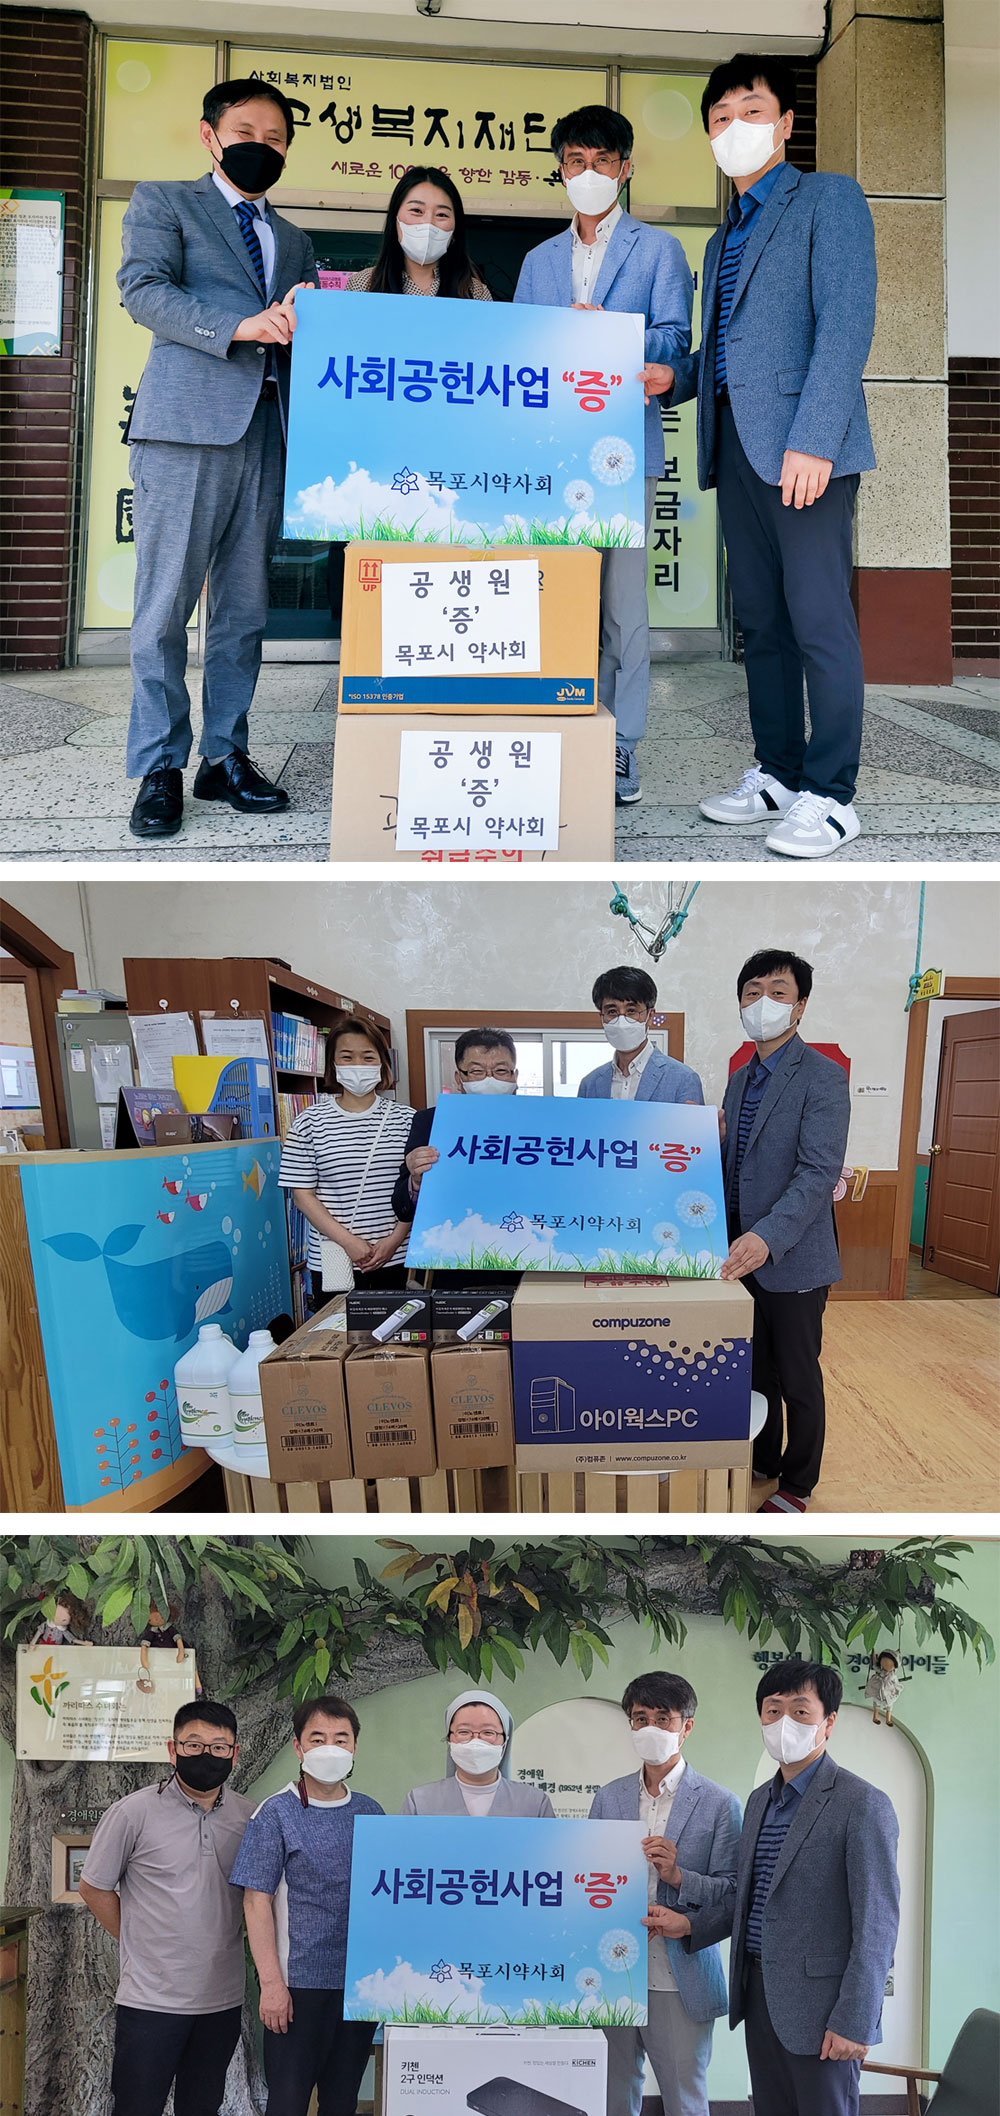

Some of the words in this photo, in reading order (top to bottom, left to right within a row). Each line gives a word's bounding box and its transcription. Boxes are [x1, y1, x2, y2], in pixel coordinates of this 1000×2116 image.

[249, 69, 352, 92] 사회복지법인
[331, 160, 383, 178] 새로운
[317, 355, 549, 409] 사회공헌사업
[426, 470, 552, 496] 목포시약사회
[653, 456, 682, 593] 보금자리
[362, 584, 377, 592] UP
[395, 643, 455, 667] 목포시
[468, 640, 526, 664] 약사회
[382, 693, 404, 701] 인증기업
[556, 682, 585, 697] JVM
[410, 816, 471, 840] 목포시
[485, 816, 544, 839] 약사회
[448, 1134, 638, 1170] 사회공헌사업
[530, 1212, 642, 1234] 목포시약사회
[592, 1316, 671, 1330] compuzone
[367, 1402, 412, 1412] CLEVOS
[450, 1394, 495, 1405] CLEVOS
[281, 1405, 328, 1416] CLEVOS
[580, 1408, 699, 1431] 아이웍스PC
[575, 1454, 606, 1463] (주)컴퓨존
[615, 1454, 687, 1463] www.compuzone.co.kr
[901, 1653, 950, 1675] 아이들
[517, 1768, 544, 1780] 경애원
[371, 1868, 563, 1907] 사회공헌사업
[457, 1961, 565, 1982] 목포시약사회
[401, 2061, 419, 2072] 키첸
[401, 2074, 416, 2085] 2구
[417, 2073, 444, 2085] 인덕션
